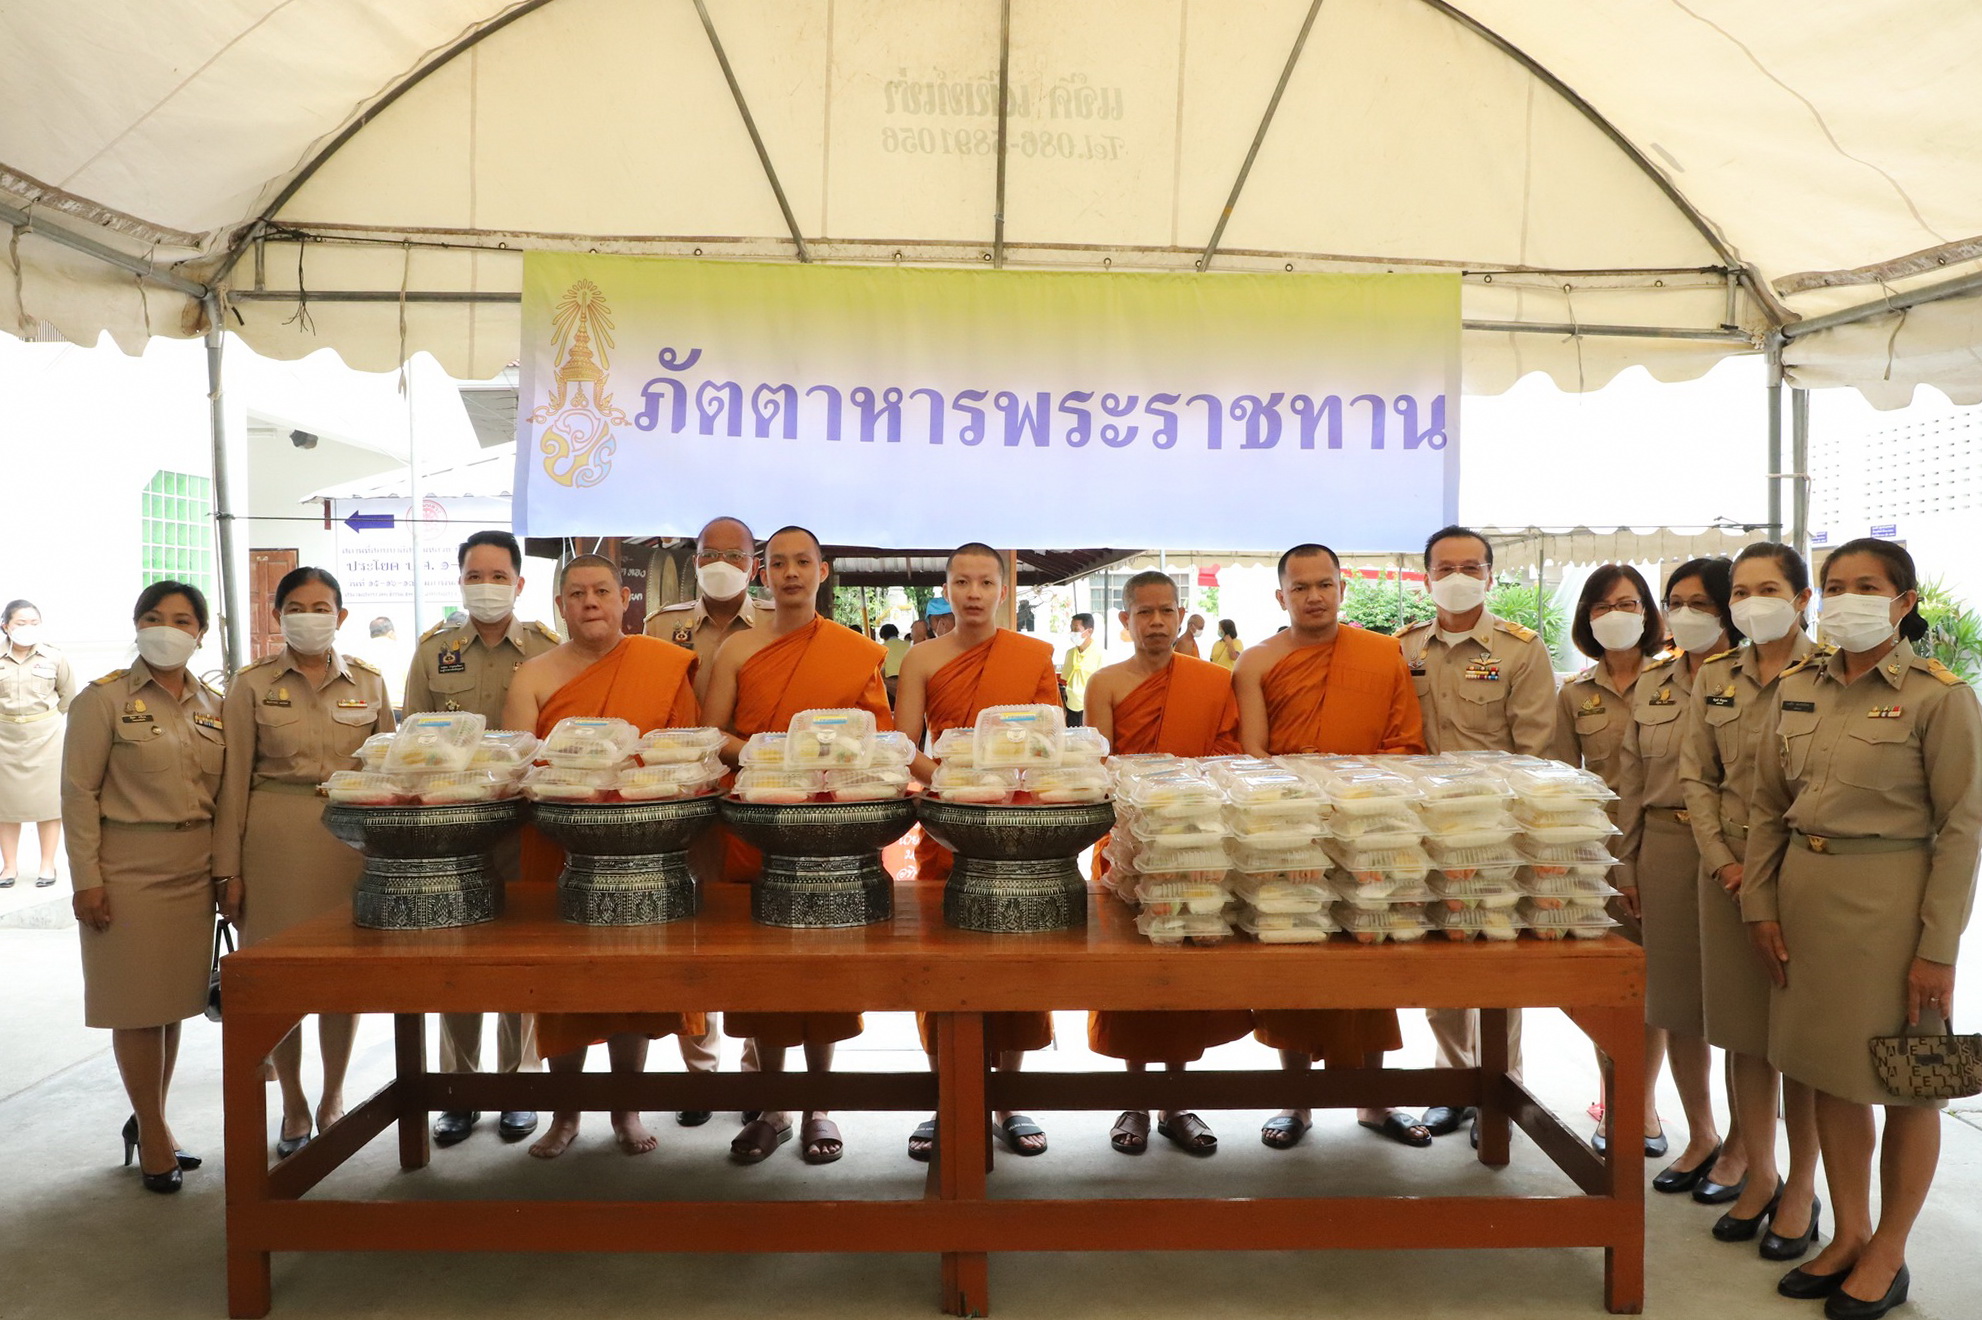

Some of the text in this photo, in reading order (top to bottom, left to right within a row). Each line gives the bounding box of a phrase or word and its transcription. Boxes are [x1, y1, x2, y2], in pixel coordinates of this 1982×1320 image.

[634, 346, 1448, 451] ภัตตาหารพระราชทาน
